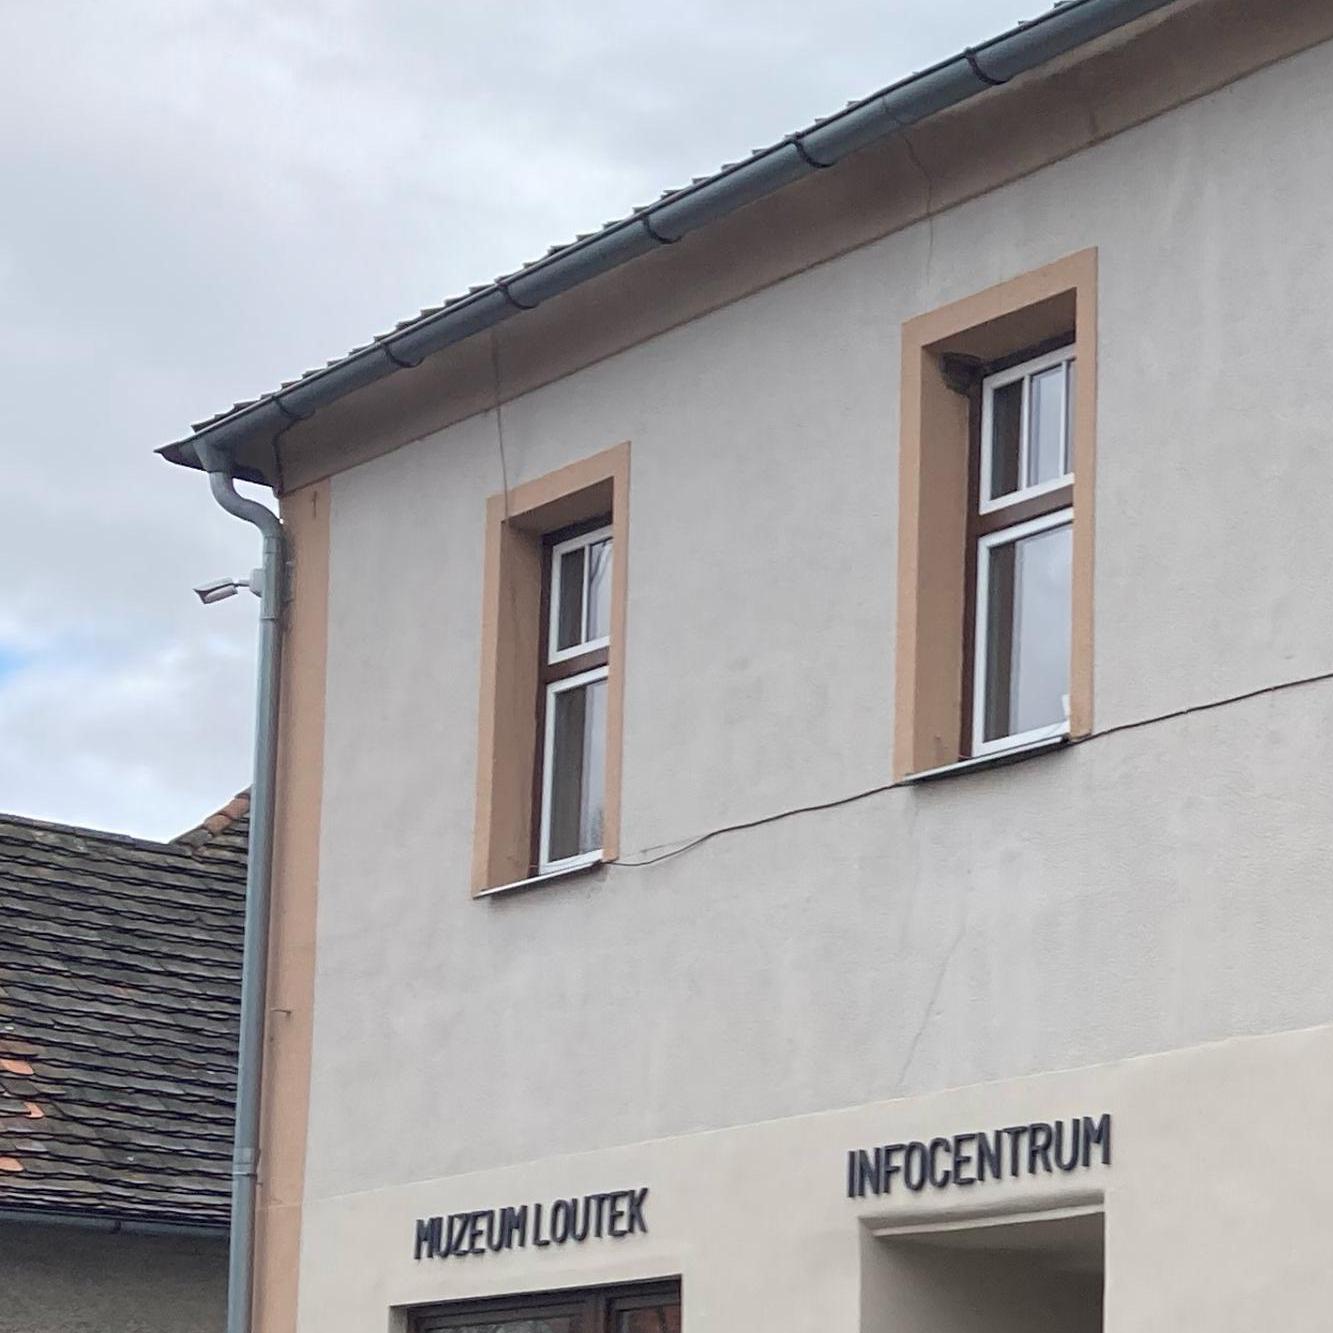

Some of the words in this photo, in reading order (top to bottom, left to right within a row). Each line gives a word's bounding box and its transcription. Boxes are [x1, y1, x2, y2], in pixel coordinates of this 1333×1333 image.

[847, 1113, 1112, 1198] INFOCENTRUM
[413, 1204, 529, 1260] MUZEUM
[533, 1188, 649, 1248] LOUTEK
